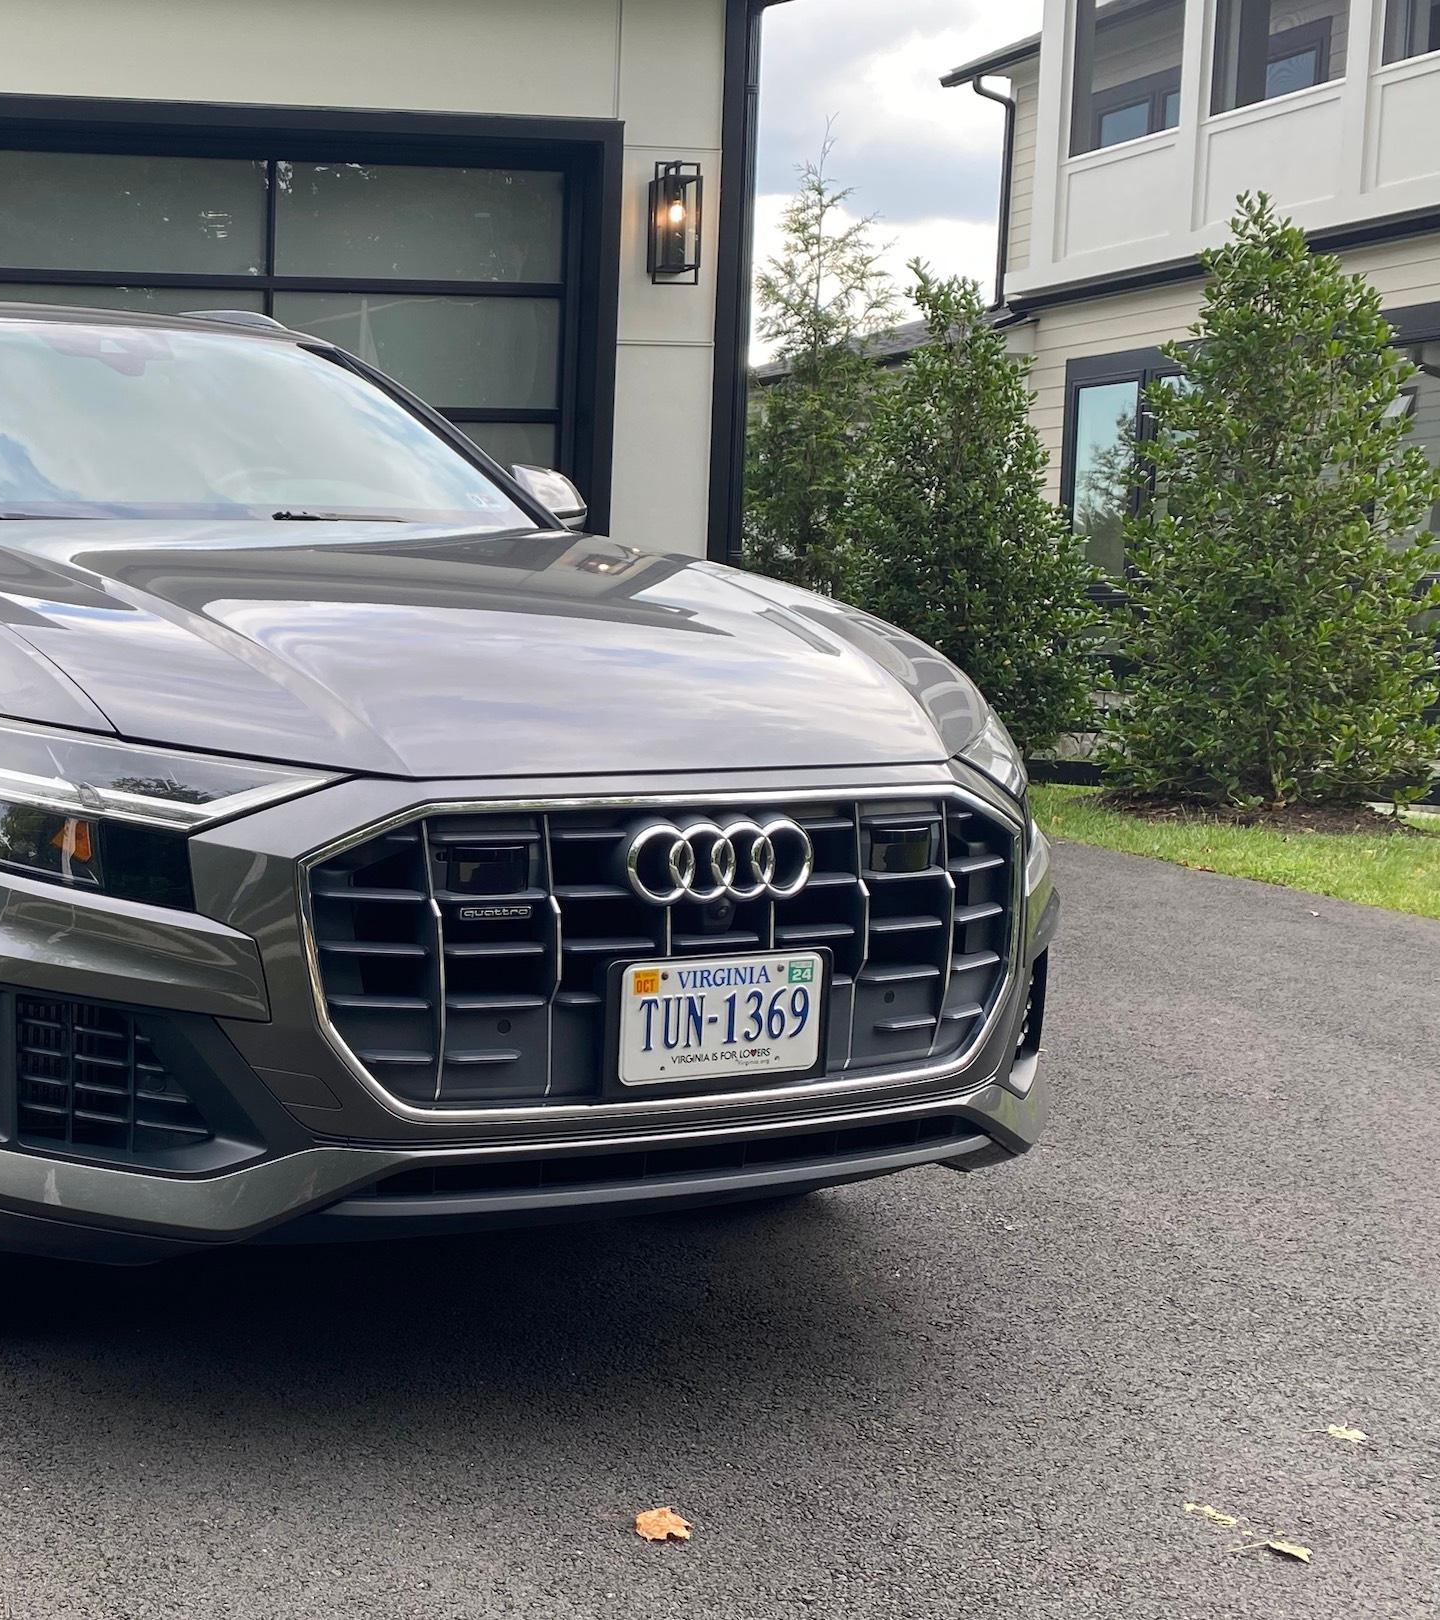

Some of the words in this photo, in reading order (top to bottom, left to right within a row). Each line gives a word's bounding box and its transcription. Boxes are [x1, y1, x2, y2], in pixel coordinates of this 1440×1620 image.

[463, 908, 529, 918] quattro
[677, 965, 771, 989] VIRGINIA
[792, 968, 812, 981] 24
[636, 978, 656, 993] OCT
[639, 985, 810, 1052] TUN-1369
[671, 1053, 710, 1064] VIRGINIA
[711, 1051, 718, 1061] IS
[720, 1050, 737, 1060] FOR
